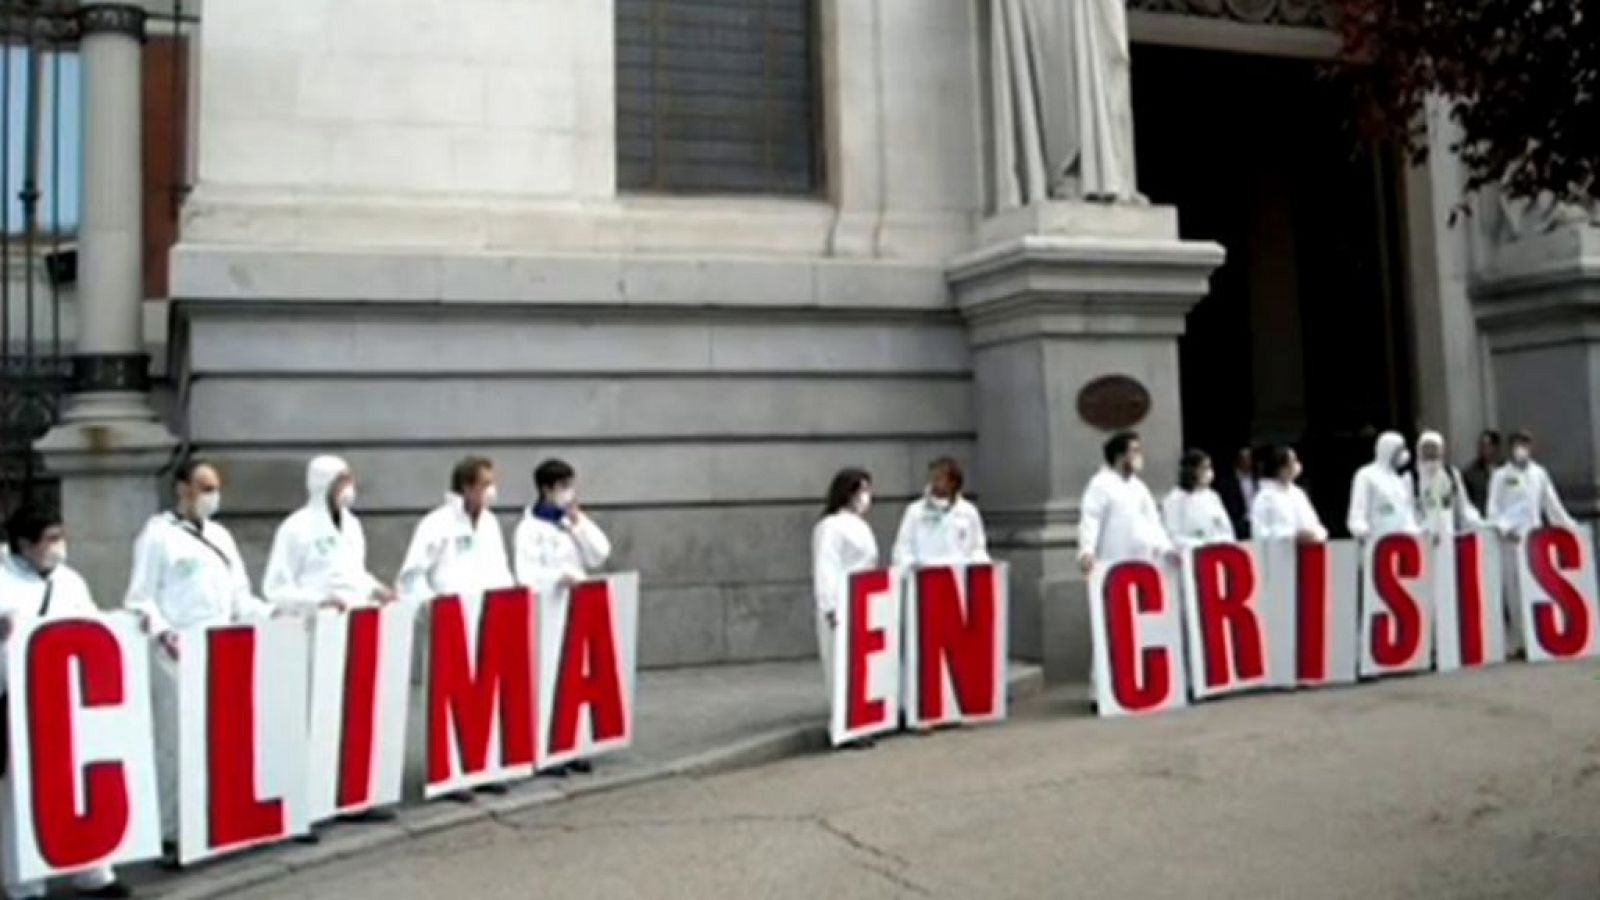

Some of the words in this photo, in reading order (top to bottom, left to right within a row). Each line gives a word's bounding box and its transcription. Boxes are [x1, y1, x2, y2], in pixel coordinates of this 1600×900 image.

[26, 580, 626, 869] CLIMA
[846, 565, 996, 731] EN
[1103, 527, 1590, 711] CRISIS
